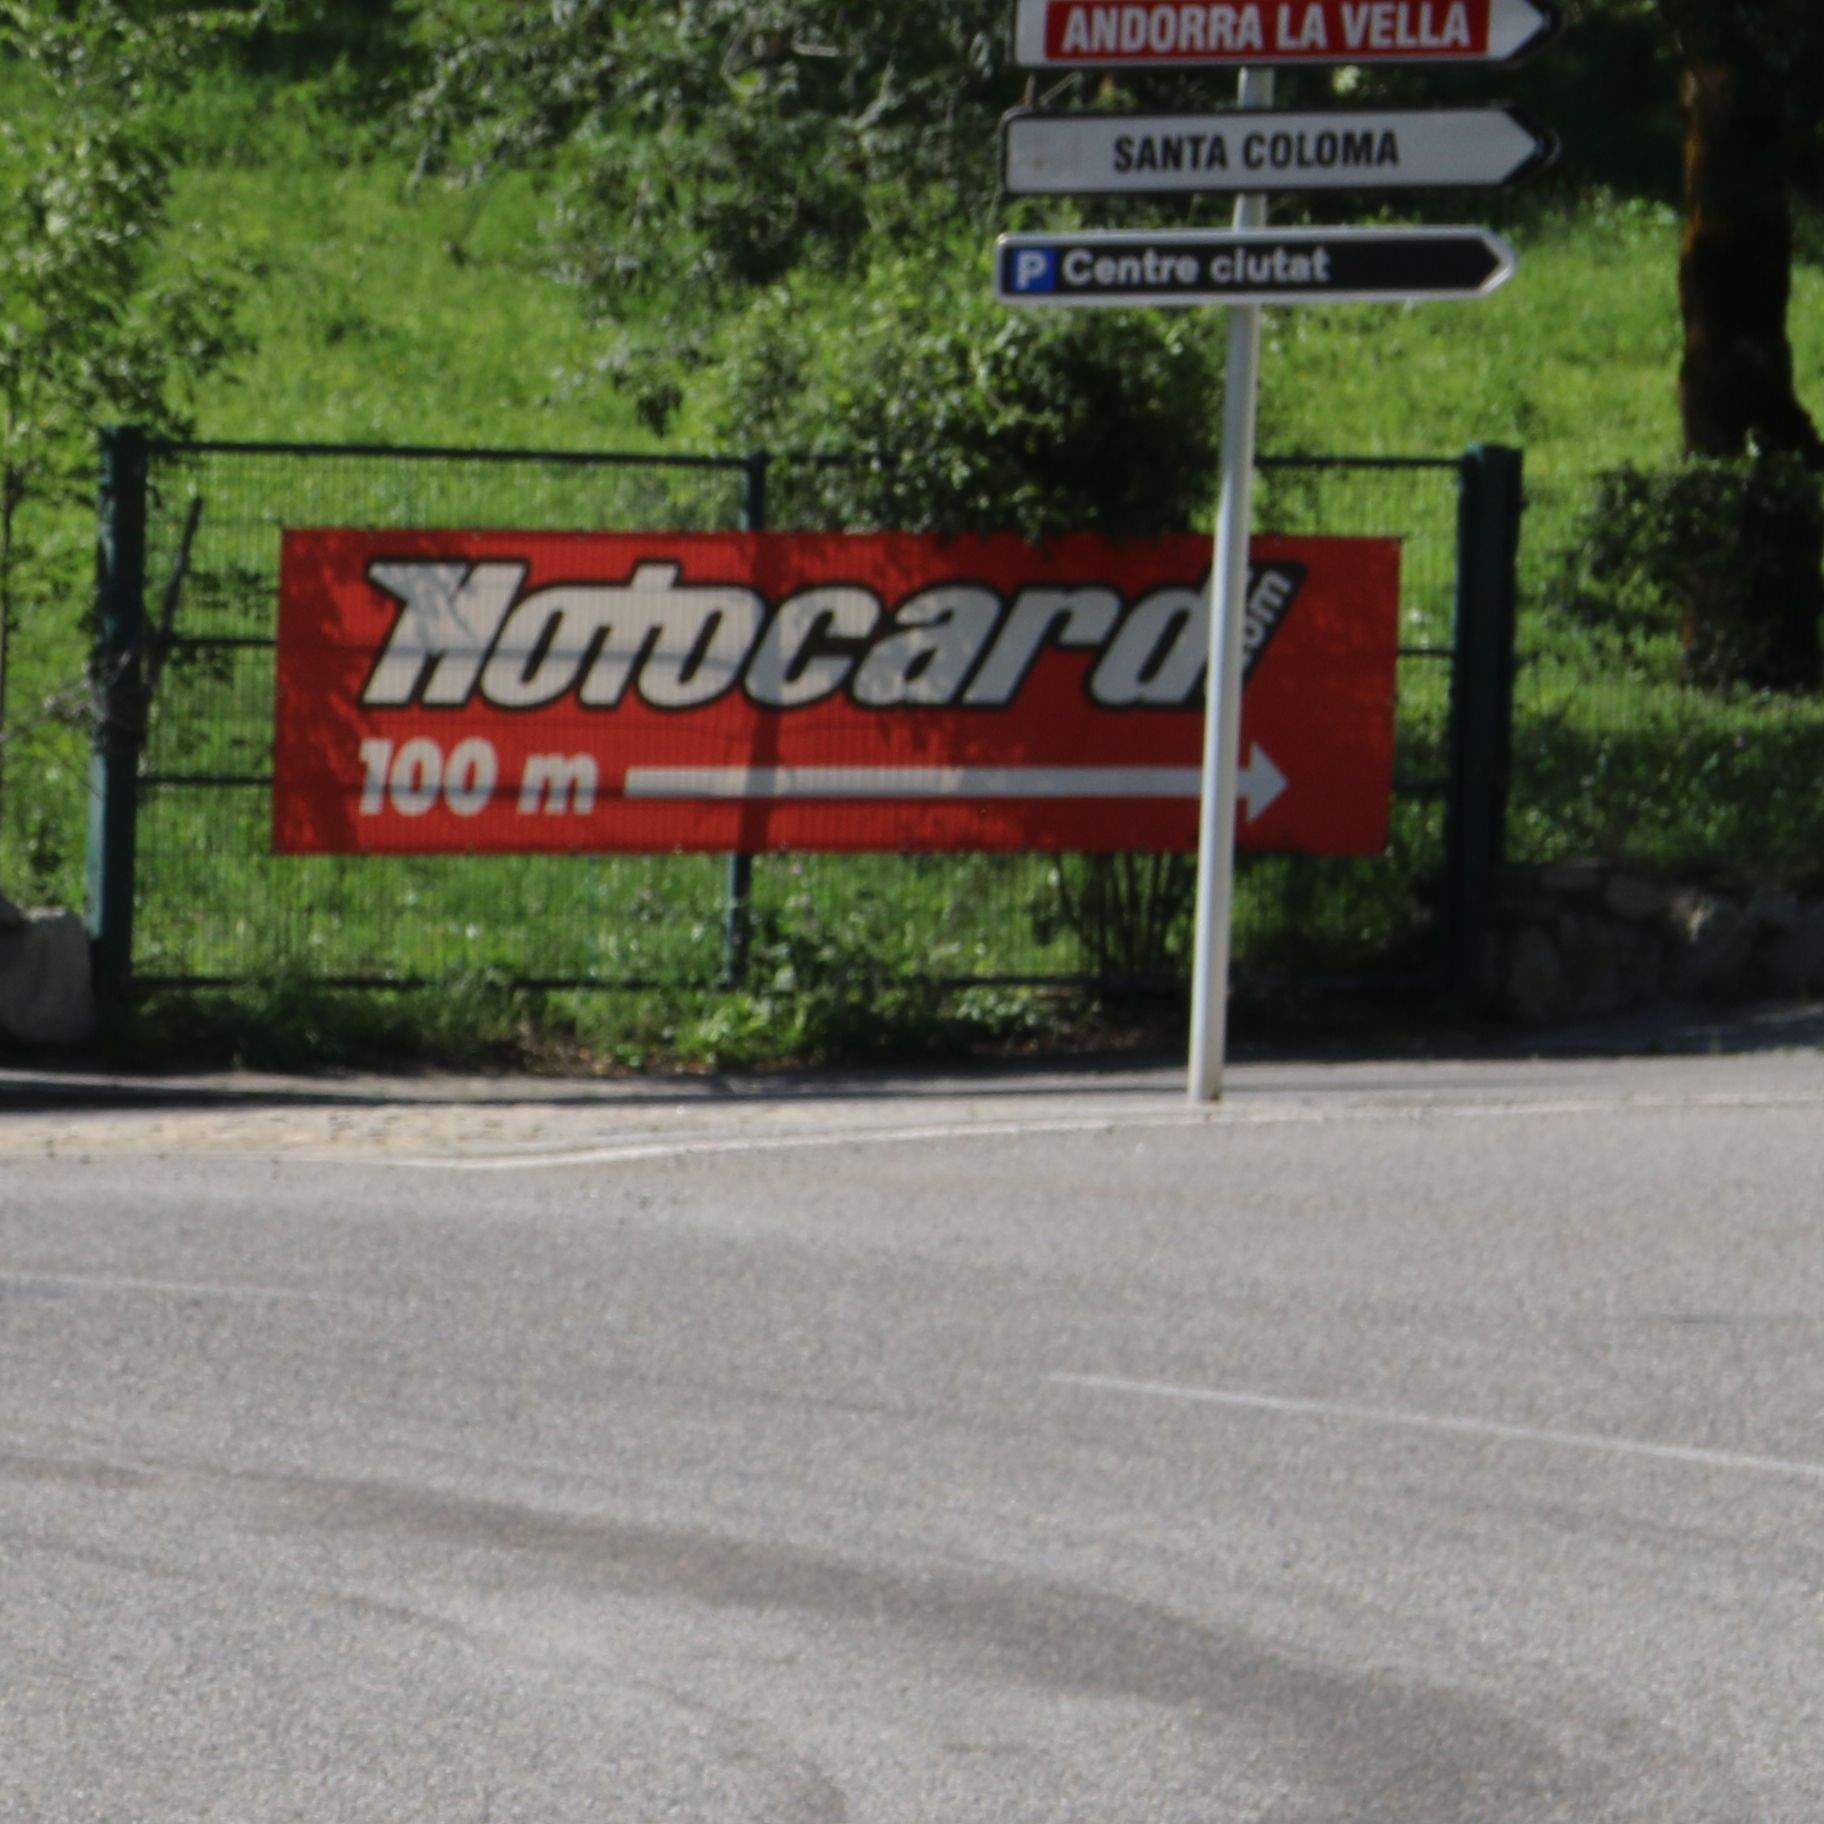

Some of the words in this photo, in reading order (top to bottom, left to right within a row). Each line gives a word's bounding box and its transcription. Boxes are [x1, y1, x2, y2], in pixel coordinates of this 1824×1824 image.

[1061, 4, 1264, 53] ANDORRA
[1276, 3, 1327, 50] LA
[1341, 1, 1472, 48] VELLA
[1112, 133, 1229, 174] SANTA
[1242, 127, 1400, 170] COLOMA
[1062, 248, 1200, 285] Centre
[1210, 246, 1332, 283] ciutat
[358, 736, 478, 817] 100
[516, 752, 599, 815] m
